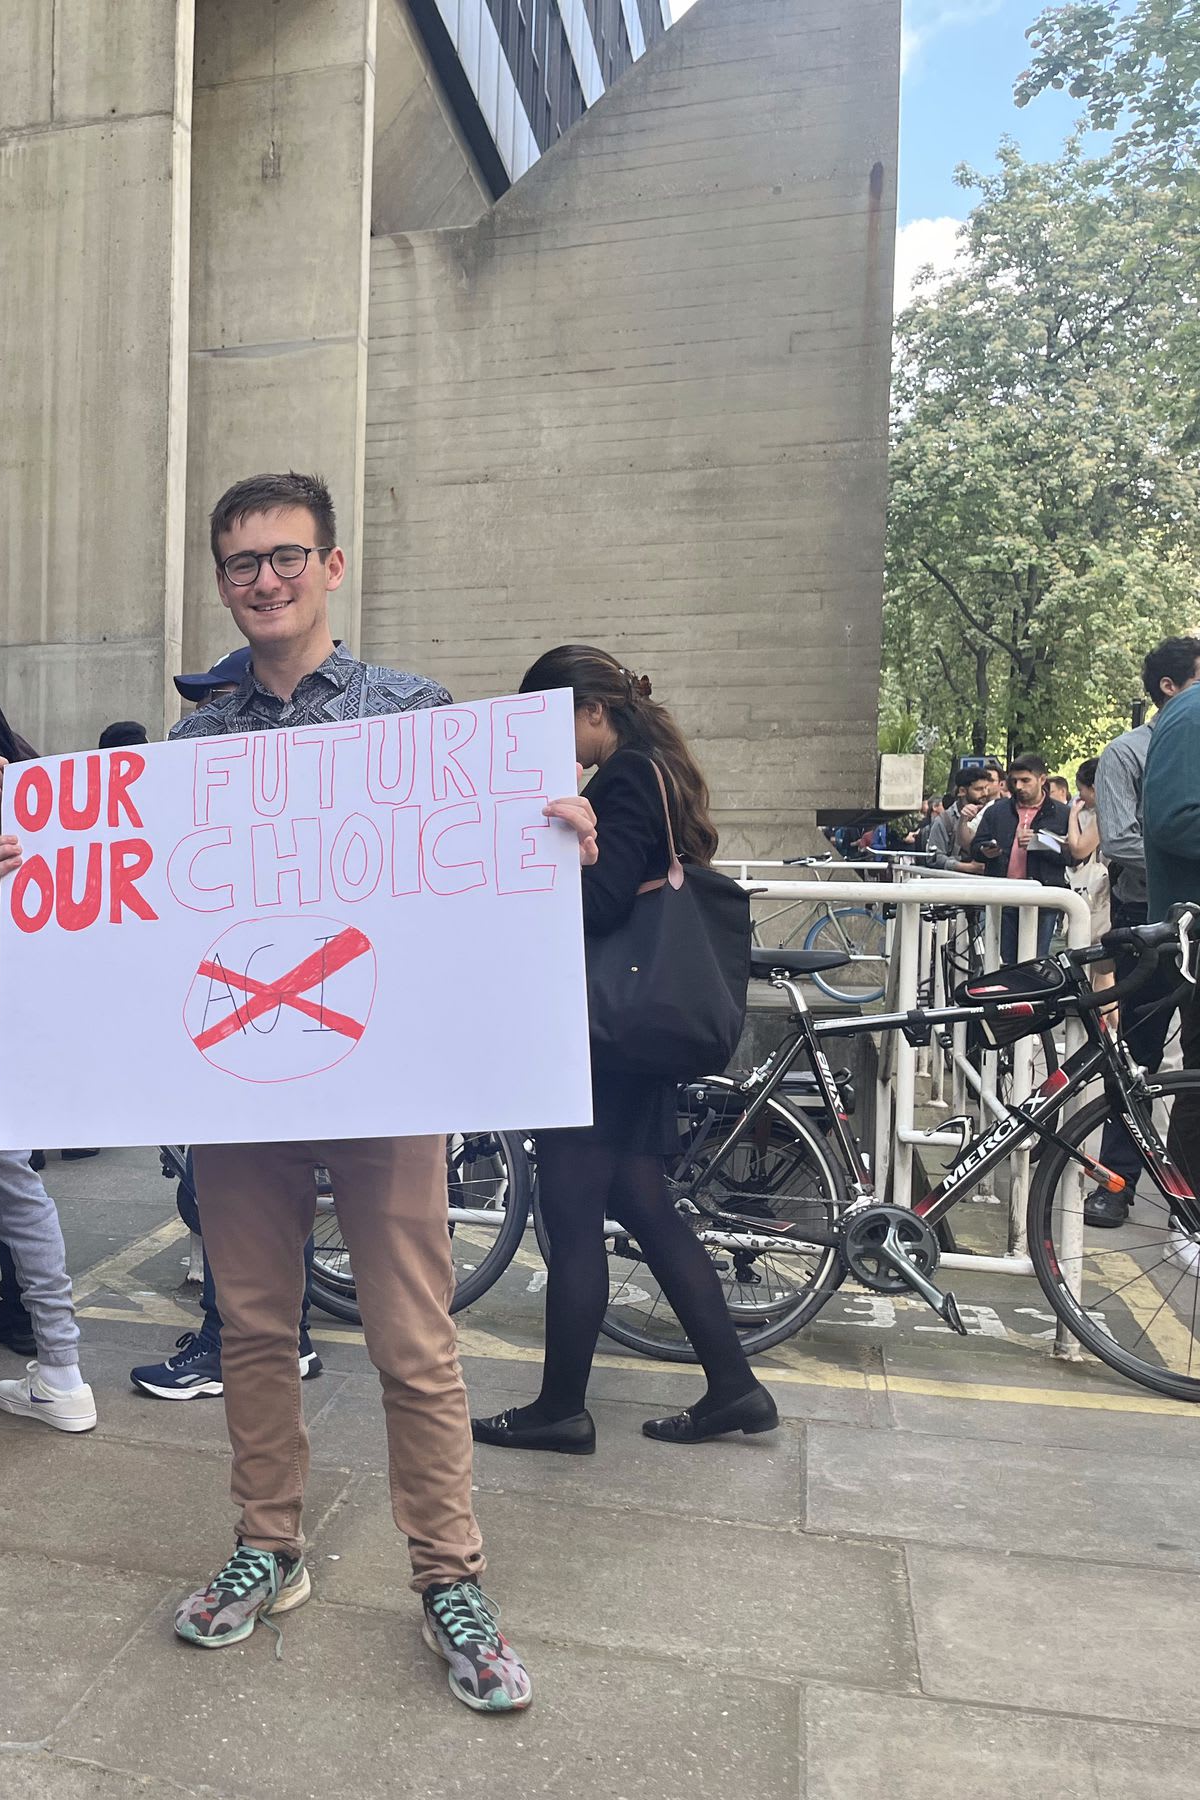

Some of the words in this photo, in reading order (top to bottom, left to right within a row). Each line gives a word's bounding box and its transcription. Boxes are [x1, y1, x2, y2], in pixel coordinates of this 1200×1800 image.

[14, 751, 146, 832] OUR
[194, 695, 545, 826] FUTURE
[10, 838, 159, 933] OUR
[167, 796, 557, 912] CHOICE
